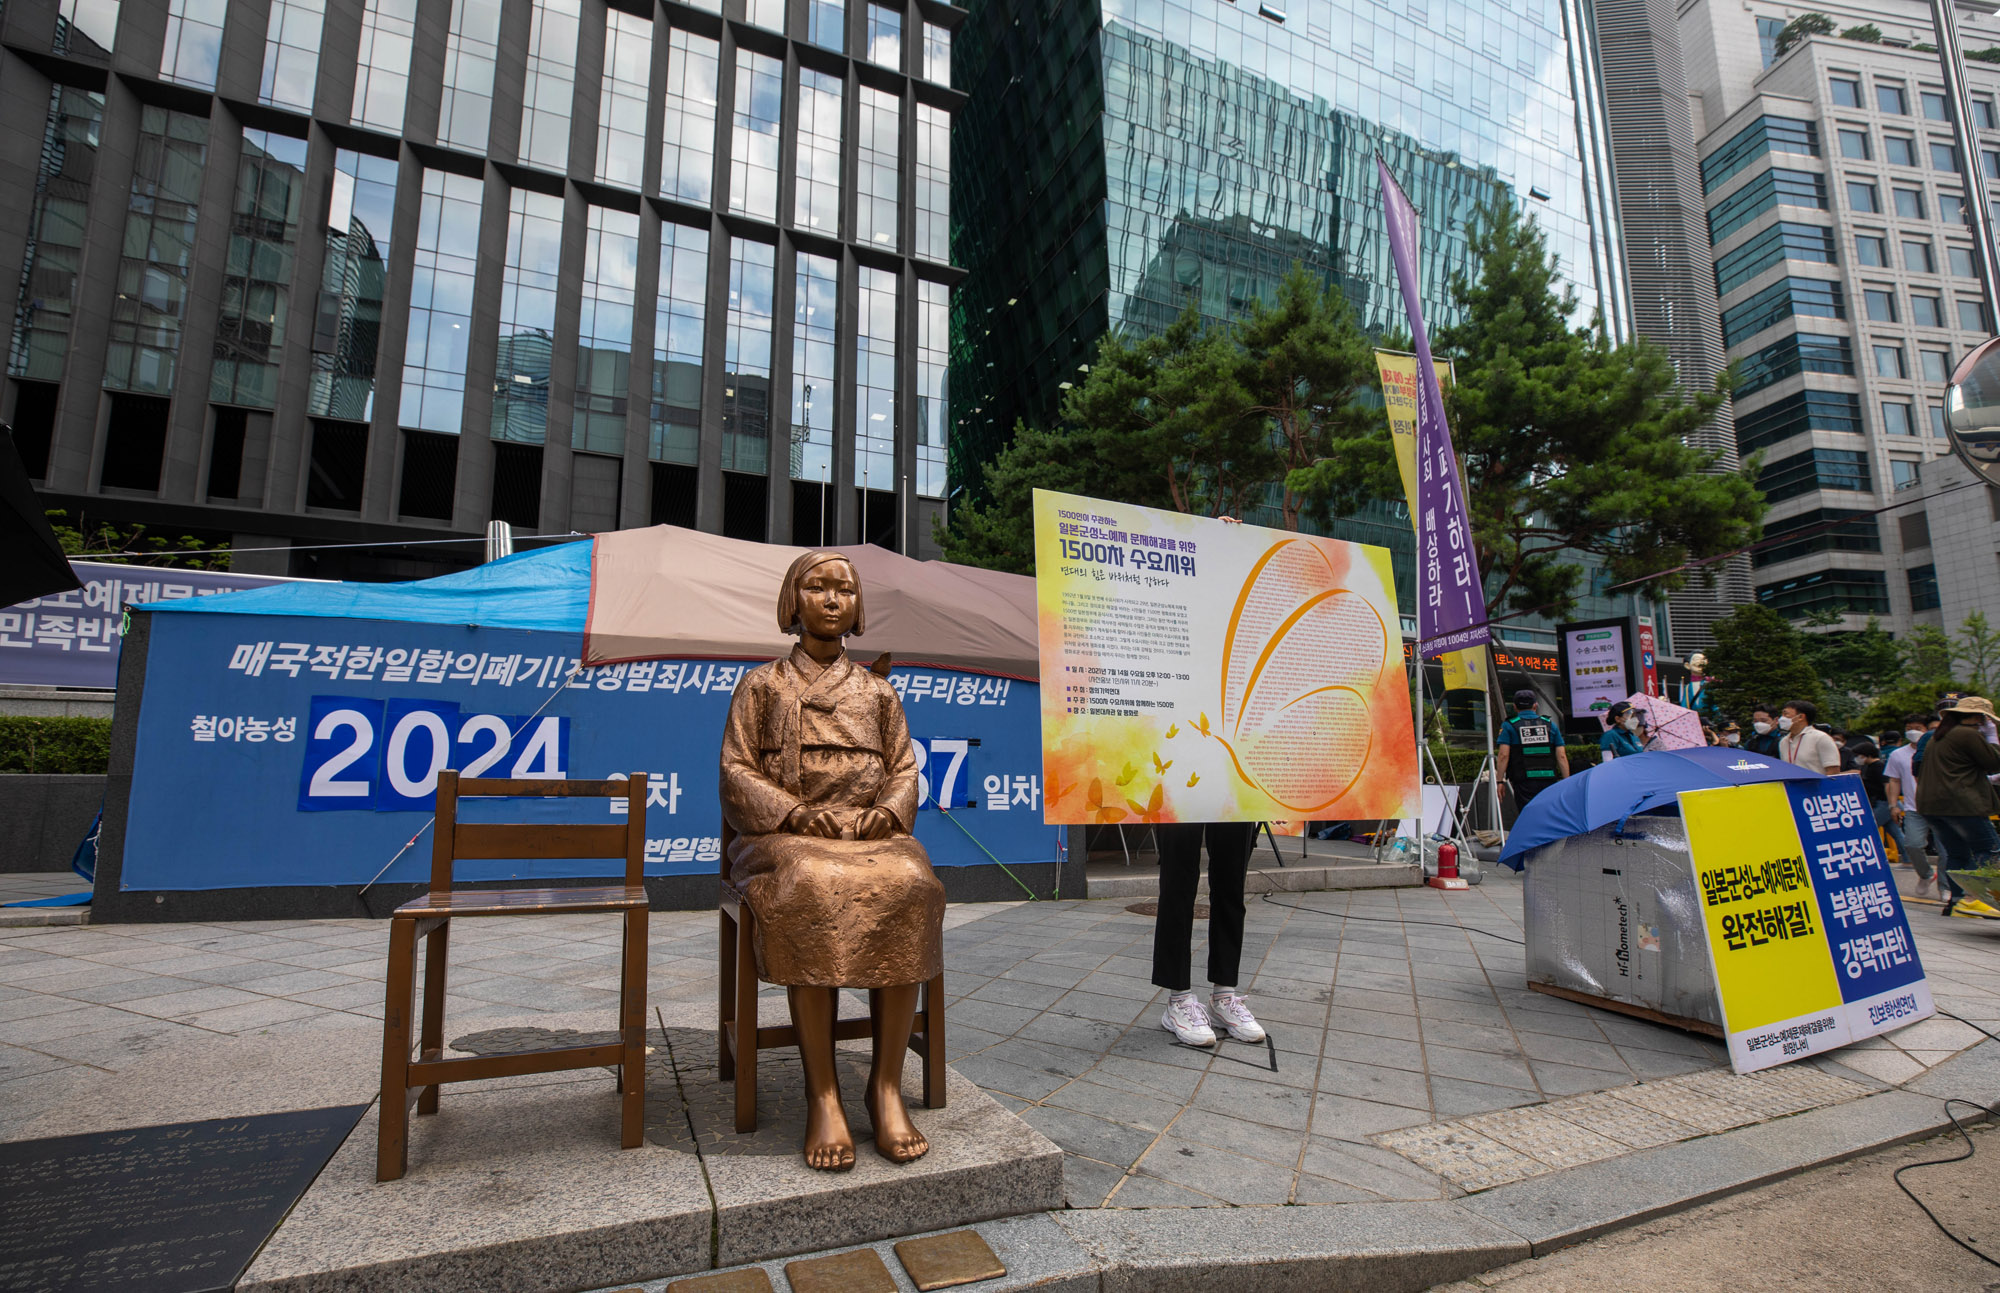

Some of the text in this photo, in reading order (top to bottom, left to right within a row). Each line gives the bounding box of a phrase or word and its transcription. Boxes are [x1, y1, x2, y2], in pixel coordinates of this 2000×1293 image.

[1058, 510, 1117, 526] 1500인이 주관하는
[1059, 522, 1196, 554] 일본군성노예제 문제해결을 위한
[1059, 538, 1196, 576] 1500차 수요시위
[1061, 566, 1087, 577] 연대의
[1092, 569, 1105, 580] 힘은
[1109, 572, 1140, 585] 바위처럼
[1449, 633, 1470, 646] 1004인
[1088, 667, 1106, 675] 2021년
[1526, 656, 1541, 670] 이전
[1542, 658, 1558, 671] 수준
[190, 709, 567, 798] 철야농성 2024
[984, 774, 1040, 811] 일차
[1802, 791, 1865, 833] 일본정부
[1817, 835, 1882, 880] 군국주의
[1701, 856, 1810, 907] 일본군성노예제문제
[1830, 881, 1896, 928] 부활책동
[1721, 900, 1815, 951] 완전해결!
[1839, 925, 1913, 979] 강력규탄!
[1868, 992, 1918, 1026] 진보학생연대
[1782, 1041, 1810, 1056] 희망나비
